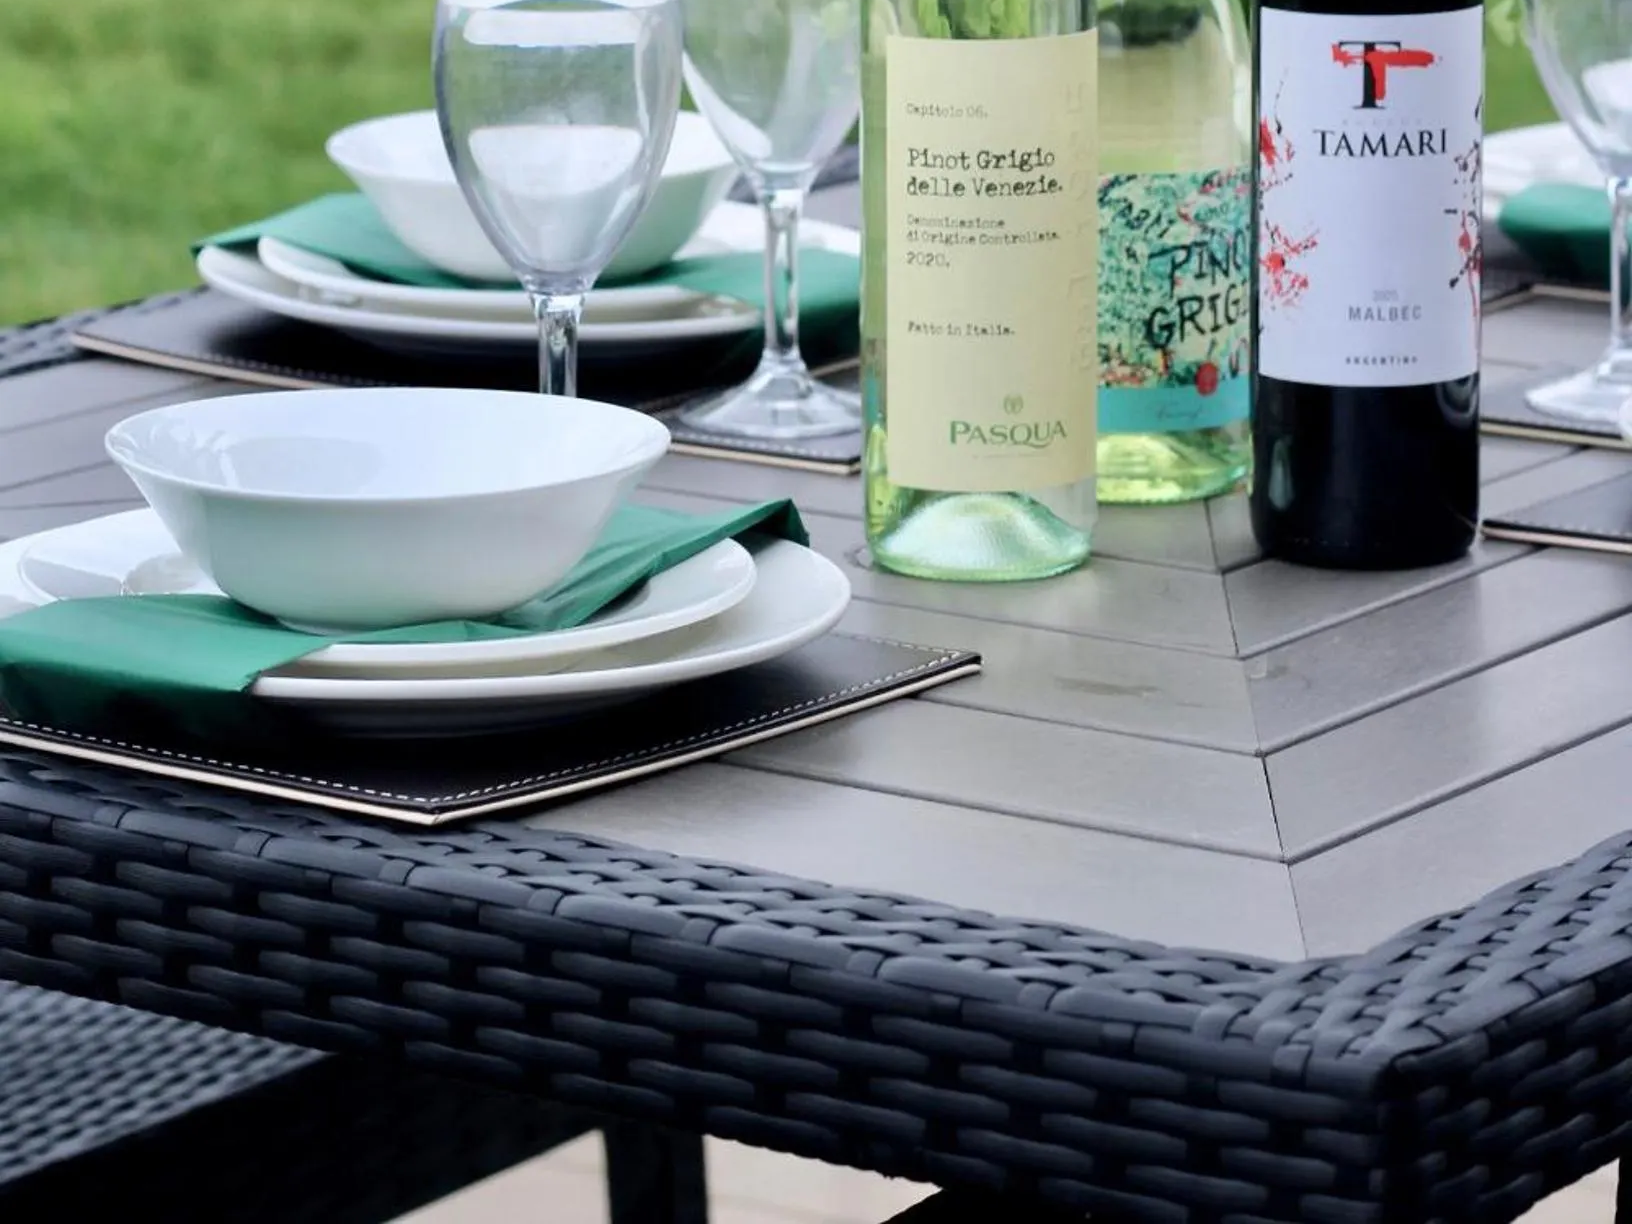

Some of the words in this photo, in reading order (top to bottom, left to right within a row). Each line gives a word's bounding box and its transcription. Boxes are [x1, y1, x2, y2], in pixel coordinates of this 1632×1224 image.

[1312, 128, 1447, 157] TAMARI
[907, 147, 970, 170] Pinot
[976, 147, 1055, 172] Grigio
[906, 176, 965, 197] delle
[972, 175, 1063, 197] Venezie.
[921, 231, 976, 246] Origine
[1348, 304, 1422, 322] MALBEC
[950, 421, 1067, 449] PASQUA
